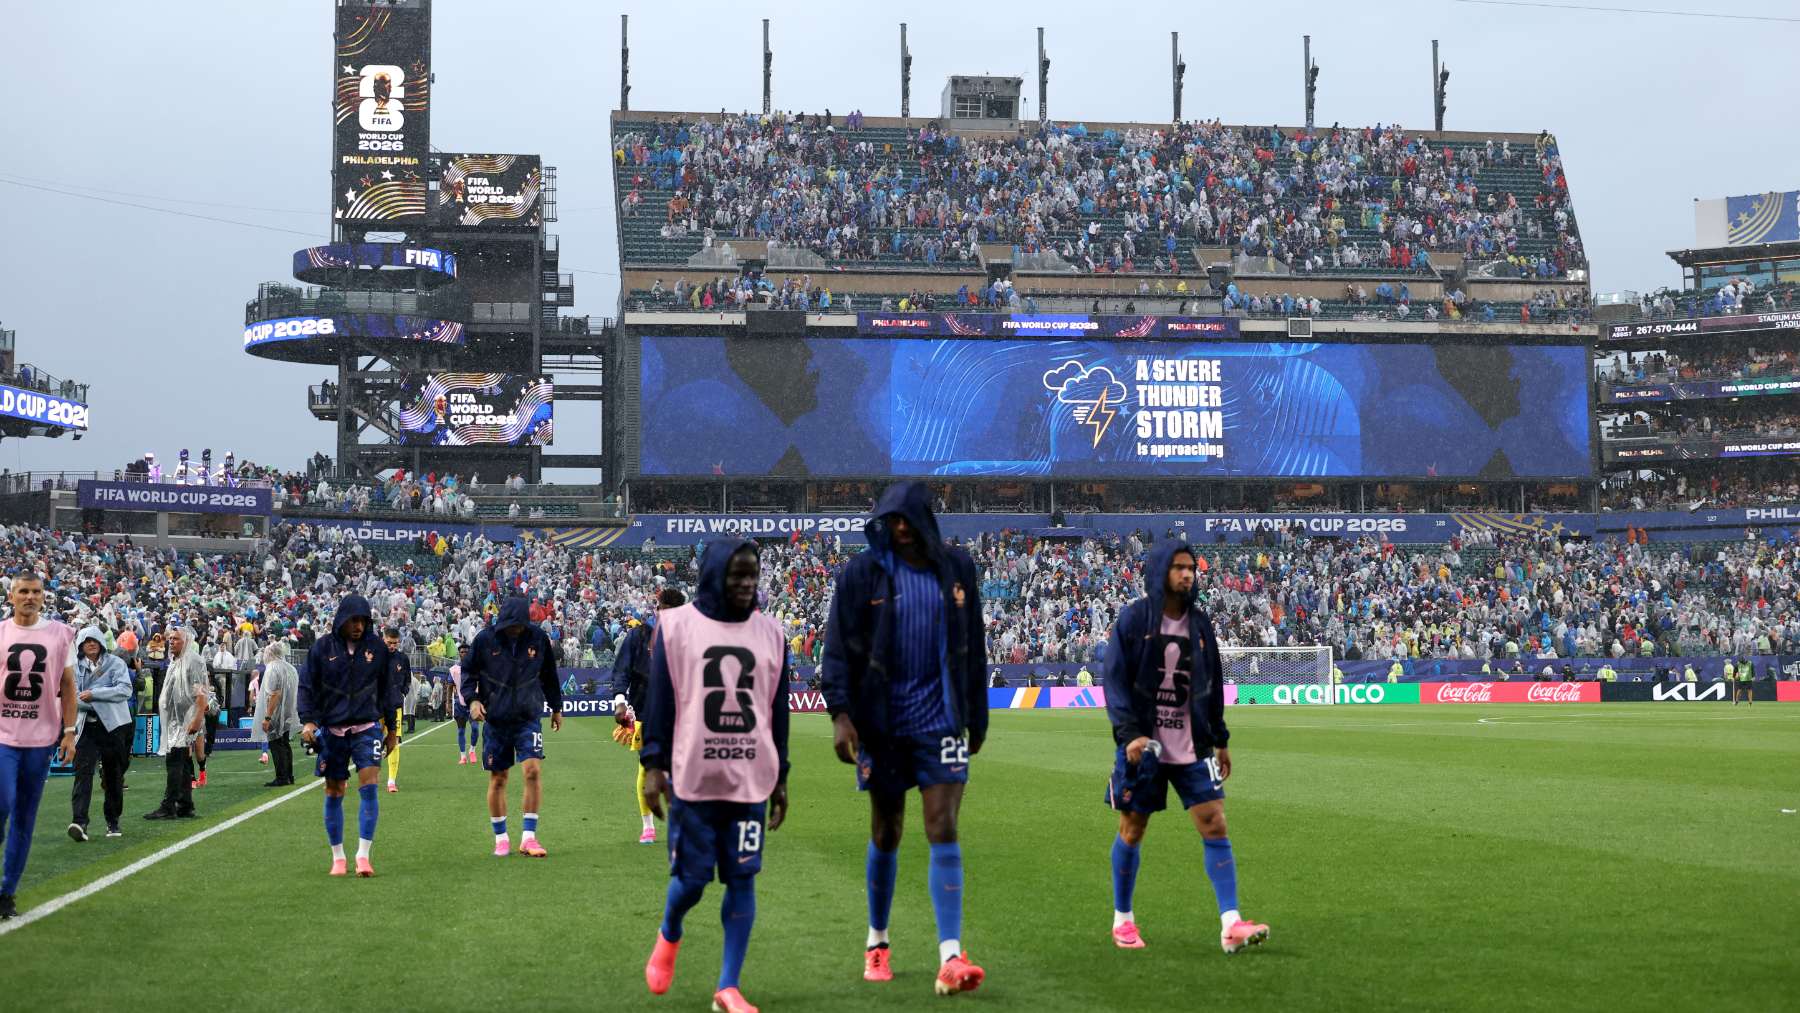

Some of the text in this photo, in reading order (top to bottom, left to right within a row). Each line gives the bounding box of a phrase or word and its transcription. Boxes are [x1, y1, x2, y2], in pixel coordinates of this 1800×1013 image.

[388, 133, 404, 141] CUP
[358, 140, 404, 151] 2026
[342, 155, 419, 165] PHILADELPHIA
[467, 177, 490, 186] FIFA
[467, 186, 504, 195] WORLD
[467, 195, 524, 204] CUP 2026
[405, 249, 439, 267] FIFA
[1758, 313, 1790, 322] STADIUM
[252, 324, 273, 341] CUP
[274, 319, 334, 337] 2026
[1002, 321, 1021, 329] FIFA
[1021, 321, 1051, 329] WORLD
[1052, 321, 1069, 329] CUP
[1636, 322, 1697, 335] 267-570-4444
[1136, 360, 1222, 381] A SEVERE
[1738, 383, 1763, 391] WORLD
[450, 393, 476, 403] FIFA
[1136, 385, 1222, 406] THUNDER
[17, 393, 46, 418] CUP
[450, 404, 493, 414] WORLD
[450, 415, 475, 424] CUP
[1136, 411, 1223, 438] STORM
[1150, 442, 1224, 457] approaching
[1725, 445, 1741, 453] FIFA
[1741, 443, 1767, 451] WORLD
[95, 488, 257, 506] FIFA WORLD CUP 2026
[1745, 508, 1800, 520] PHIL
[667, 517, 872, 533] FIFA WORLD CUP 202
[1205, 519, 1242, 532] FFA
[1309, 518, 1344, 532] CUP
[1346, 518, 1407, 532] 2026
[15, 690, 32, 698] FIFA
[1156, 691, 1177, 702] FIFA
[1273, 684, 1385, 704] aramco
[1436, 682, 1496, 703] Coca-Cola
[1527, 682, 1584, 702] Coca-Cola
[1, 709, 39, 719] 2026
[719, 715, 745, 726] FIFA
[531, 731, 543, 747] 19
[703, 747, 757, 760] 2026
[941, 736, 969, 764] 22
[737, 820, 762, 852] 13
